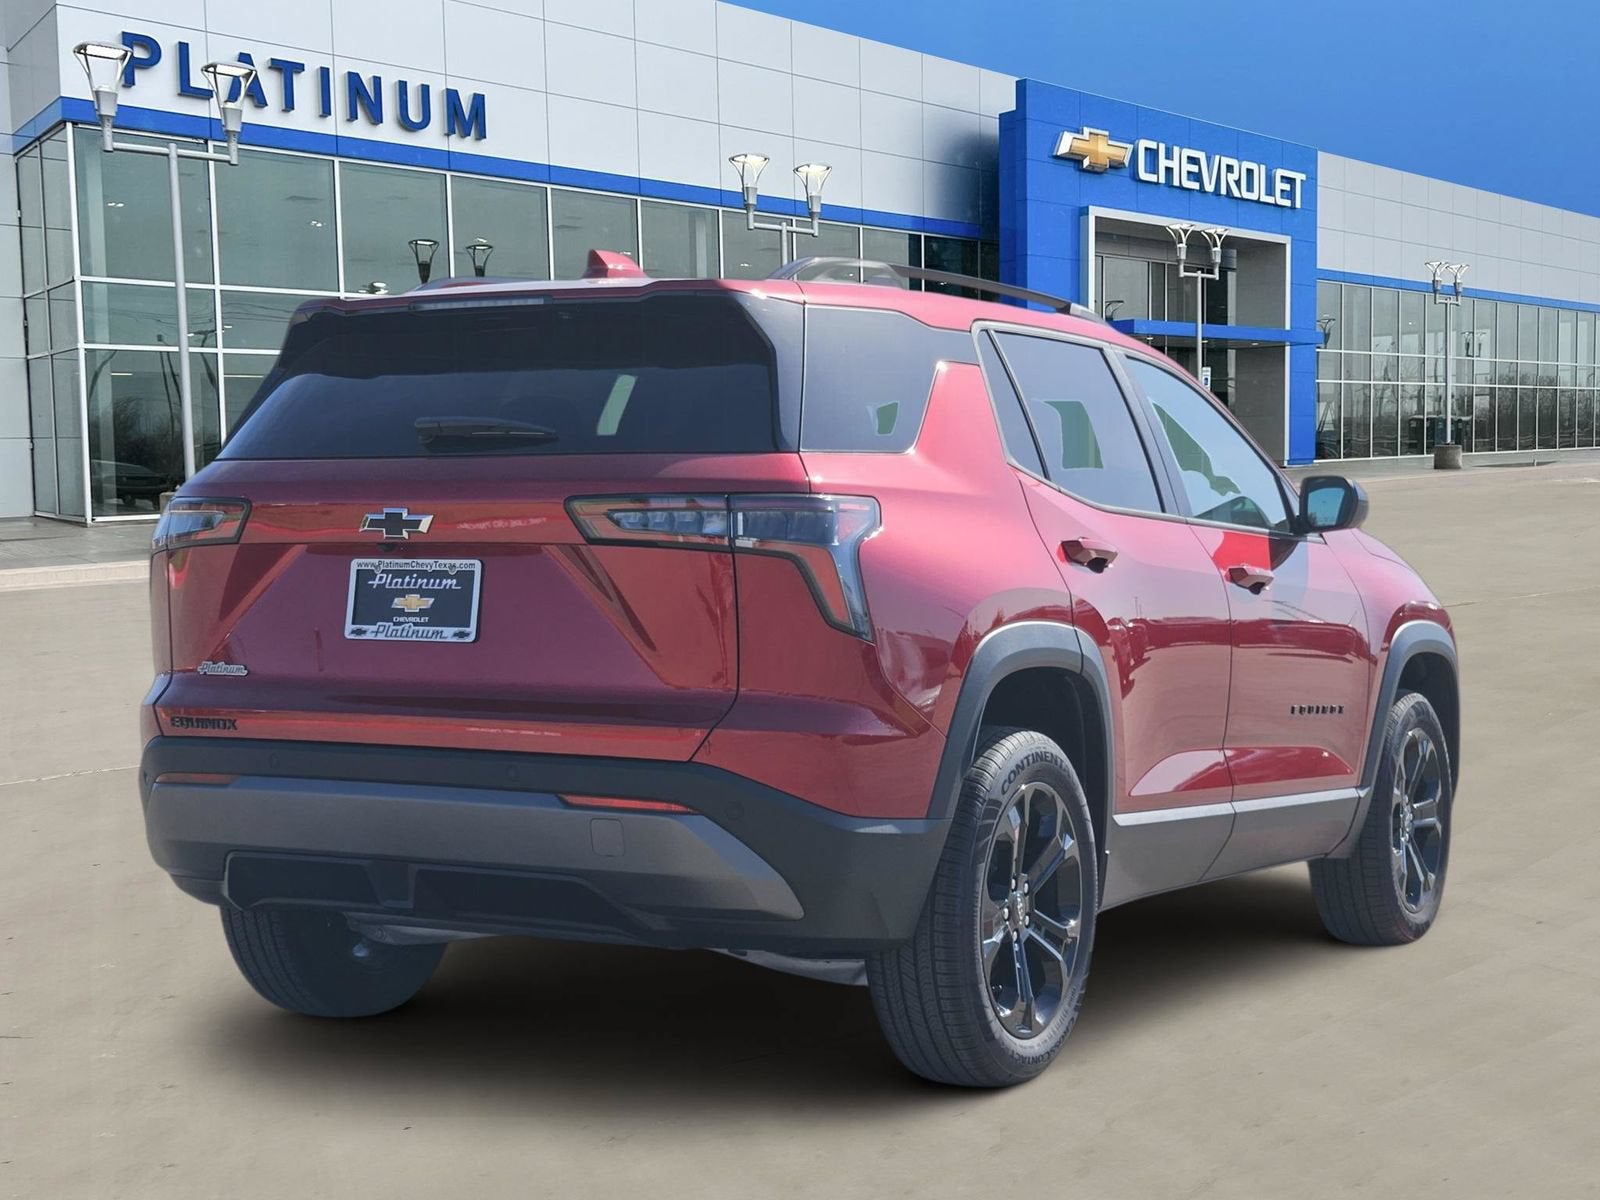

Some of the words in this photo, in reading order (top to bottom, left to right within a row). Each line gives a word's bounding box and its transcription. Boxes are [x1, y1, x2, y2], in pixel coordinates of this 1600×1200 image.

[121, 31, 488, 141] PLATINUM
[1136, 138, 1307, 209] CHEVROLET
[368, 573, 462, 589] Platinum
[370, 623, 449, 640] Platinum
[198, 661, 248, 676] Platinum
[171, 716, 238, 731] EQUINOX
